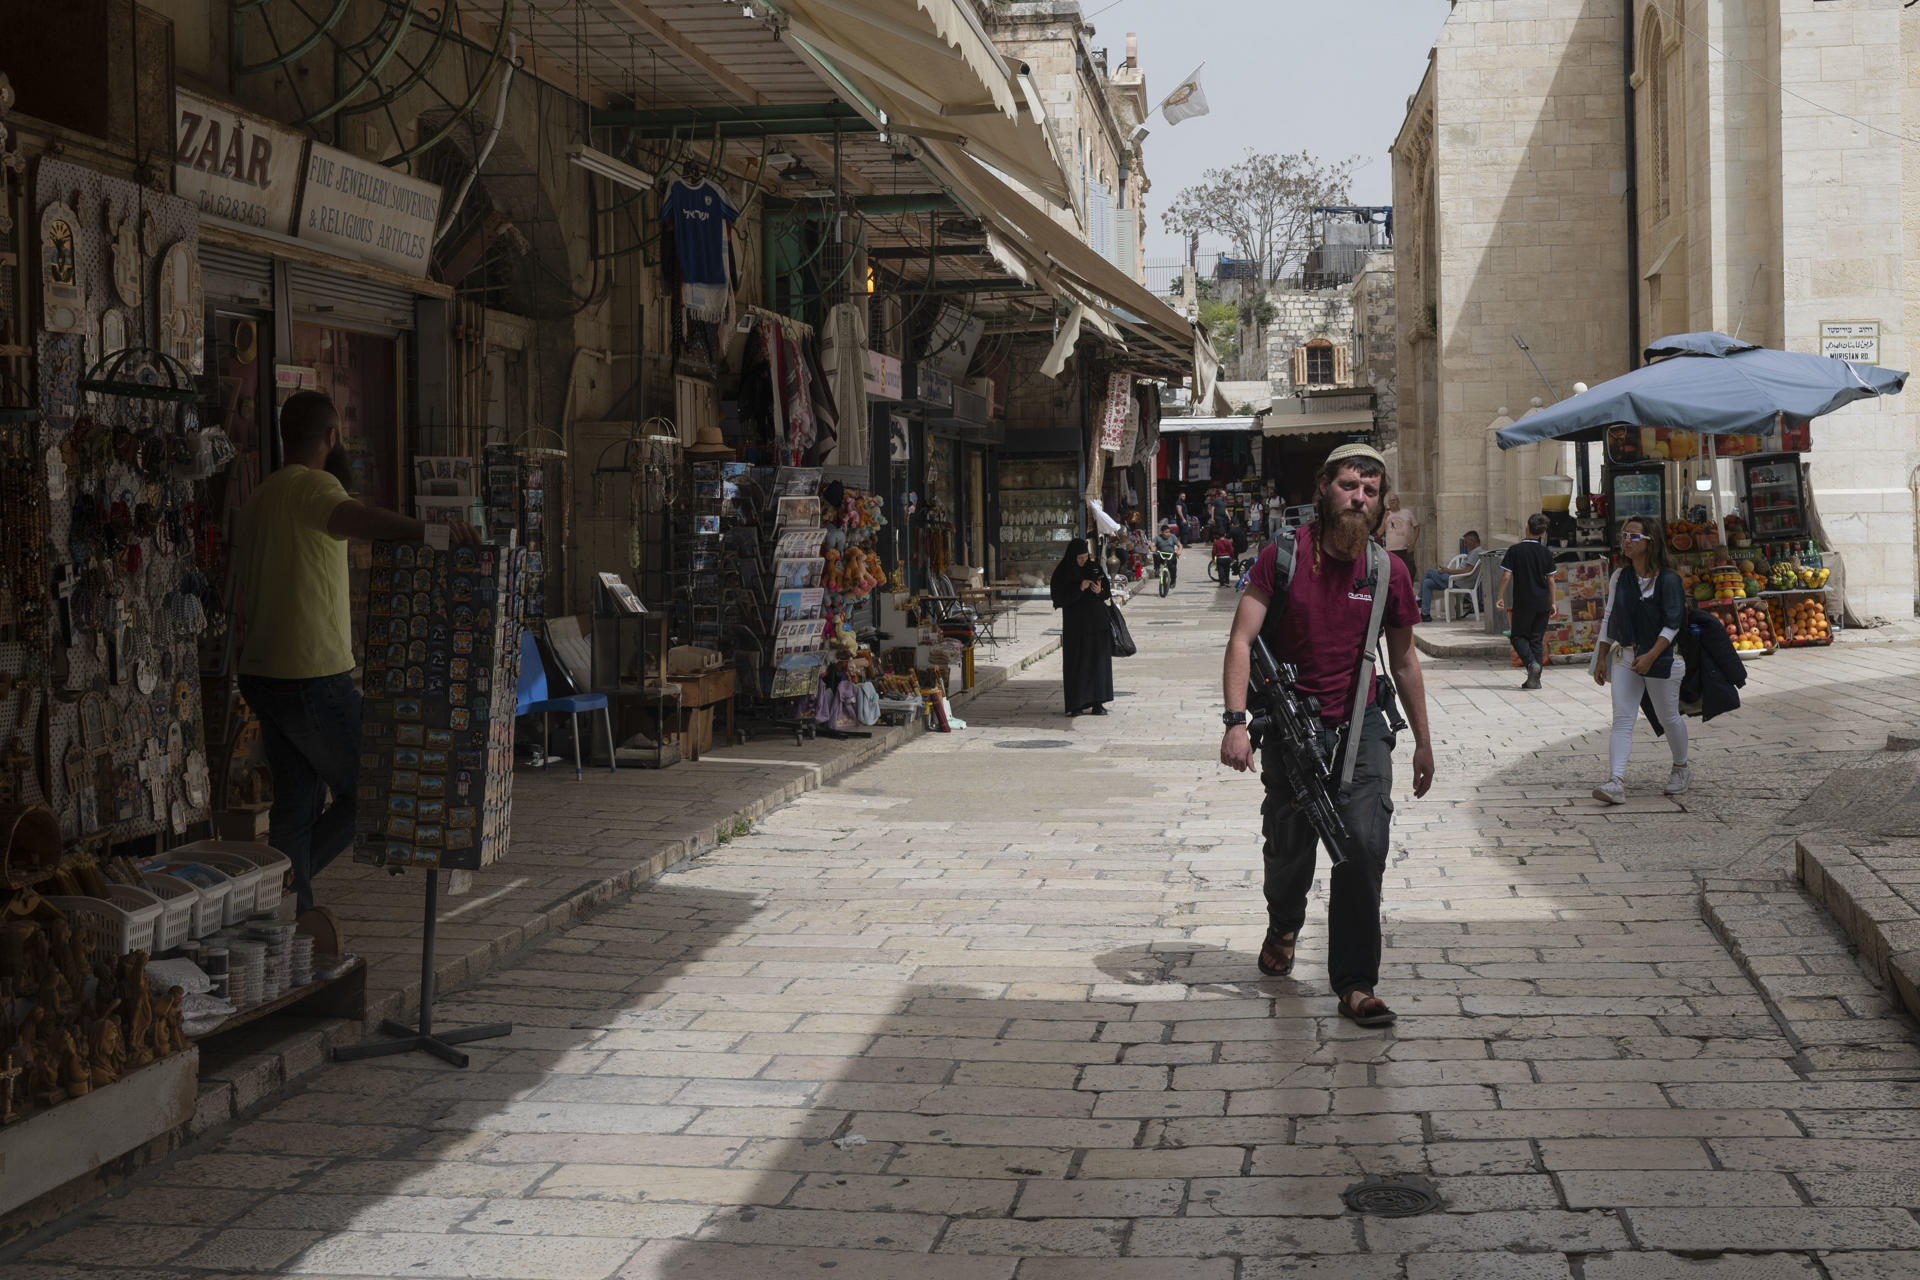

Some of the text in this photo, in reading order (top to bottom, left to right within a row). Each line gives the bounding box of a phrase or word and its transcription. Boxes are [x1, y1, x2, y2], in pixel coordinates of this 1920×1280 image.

[310, 155, 334, 188] FINE
[391, 184, 437, 223] SOUVENIRS
[682, 208, 709, 221] ישראל
[309, 205, 426, 259] & RELIGIOUS ARTICLES
[1829, 352, 1859, 360] MURISTAN
[1727, 551, 1755, 560] ocktails
